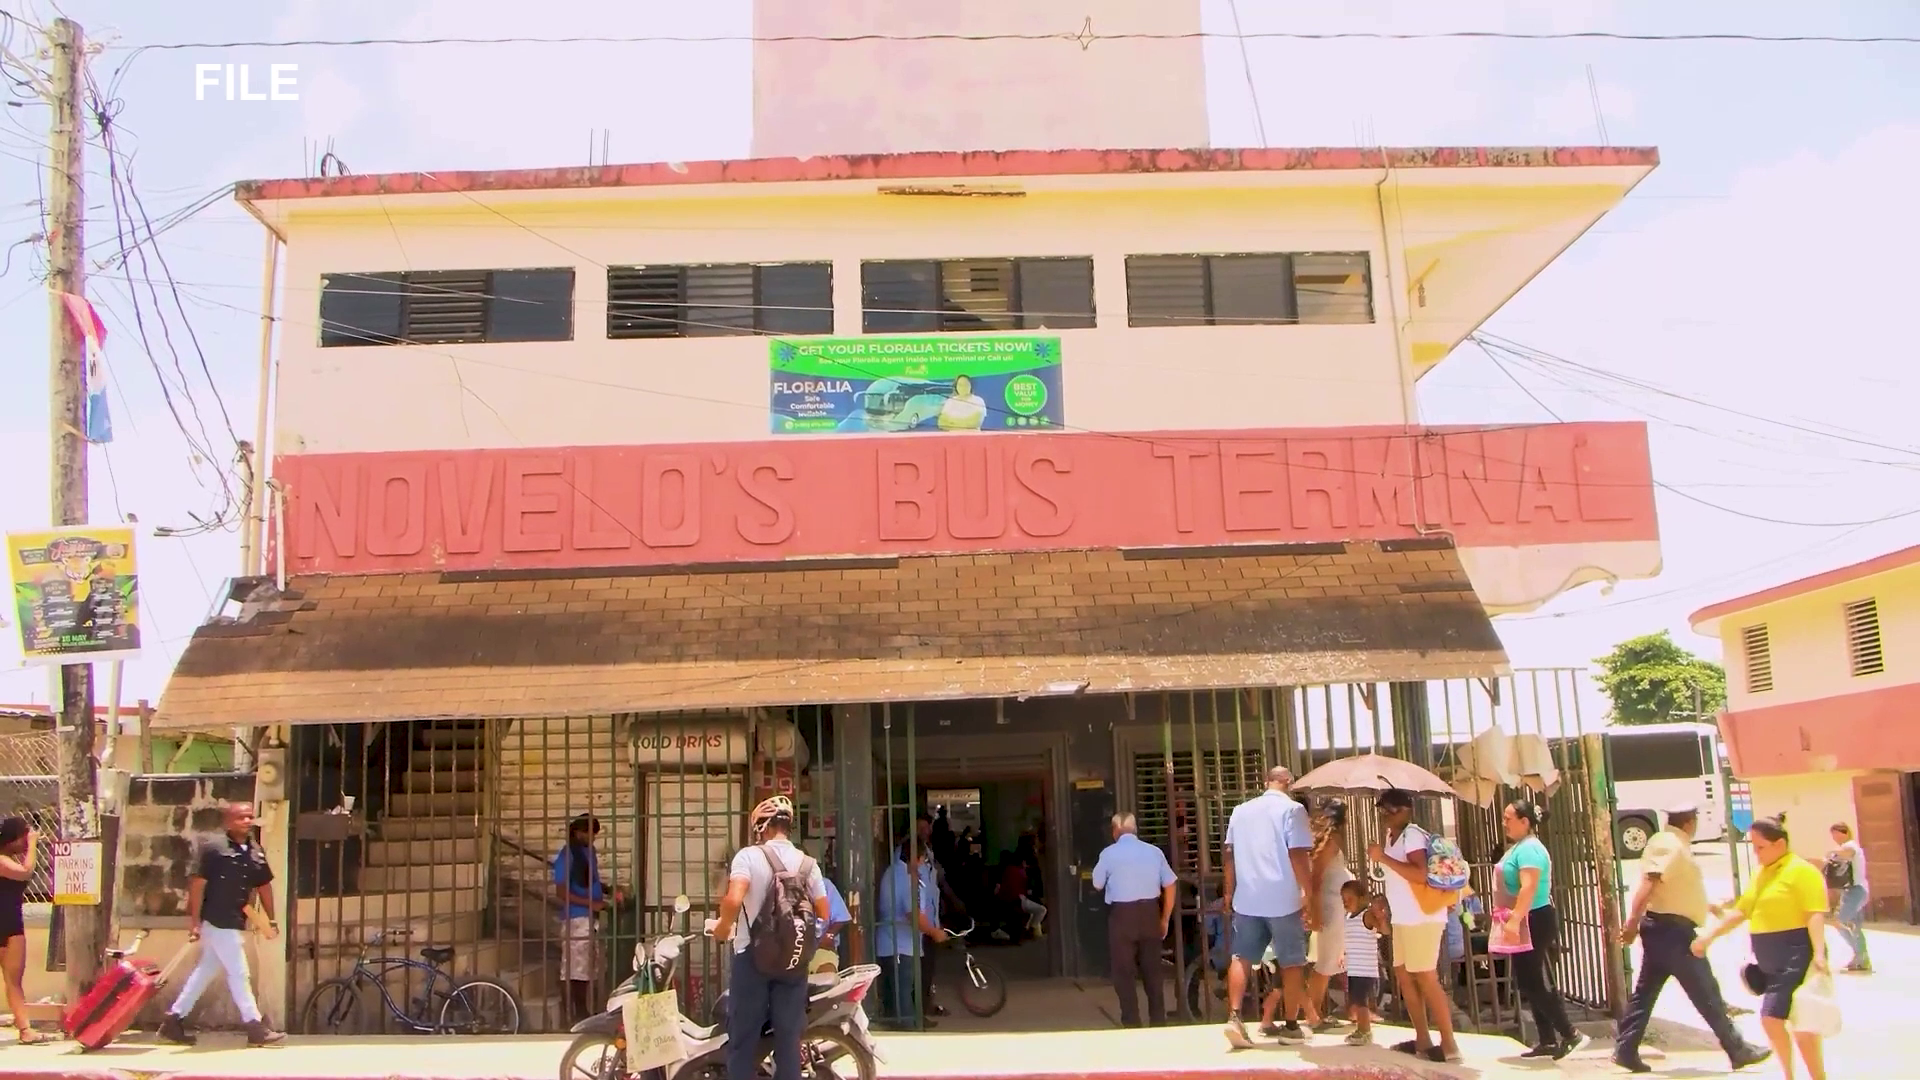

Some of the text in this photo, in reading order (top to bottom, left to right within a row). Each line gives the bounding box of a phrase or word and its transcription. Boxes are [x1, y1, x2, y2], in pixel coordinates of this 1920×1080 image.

[799, 342, 1032, 356] GET YOUR FLORALIA TICKETS NOW!
[881, 356, 904, 365] Agent
[943, 354, 976, 362] Terminal
[774, 381, 853, 394] FLORALIA
[1014, 383, 1037, 391] BEST
[790, 402, 835, 410] Comfortable
[297, 432, 1633, 558] NOVELO'S BUS TERMINAL
[55, 843, 70, 855] NO
[58, 857, 93, 869] PARKING
[66, 871, 86, 881] ANY
[65, 883, 87, 894] TIME
